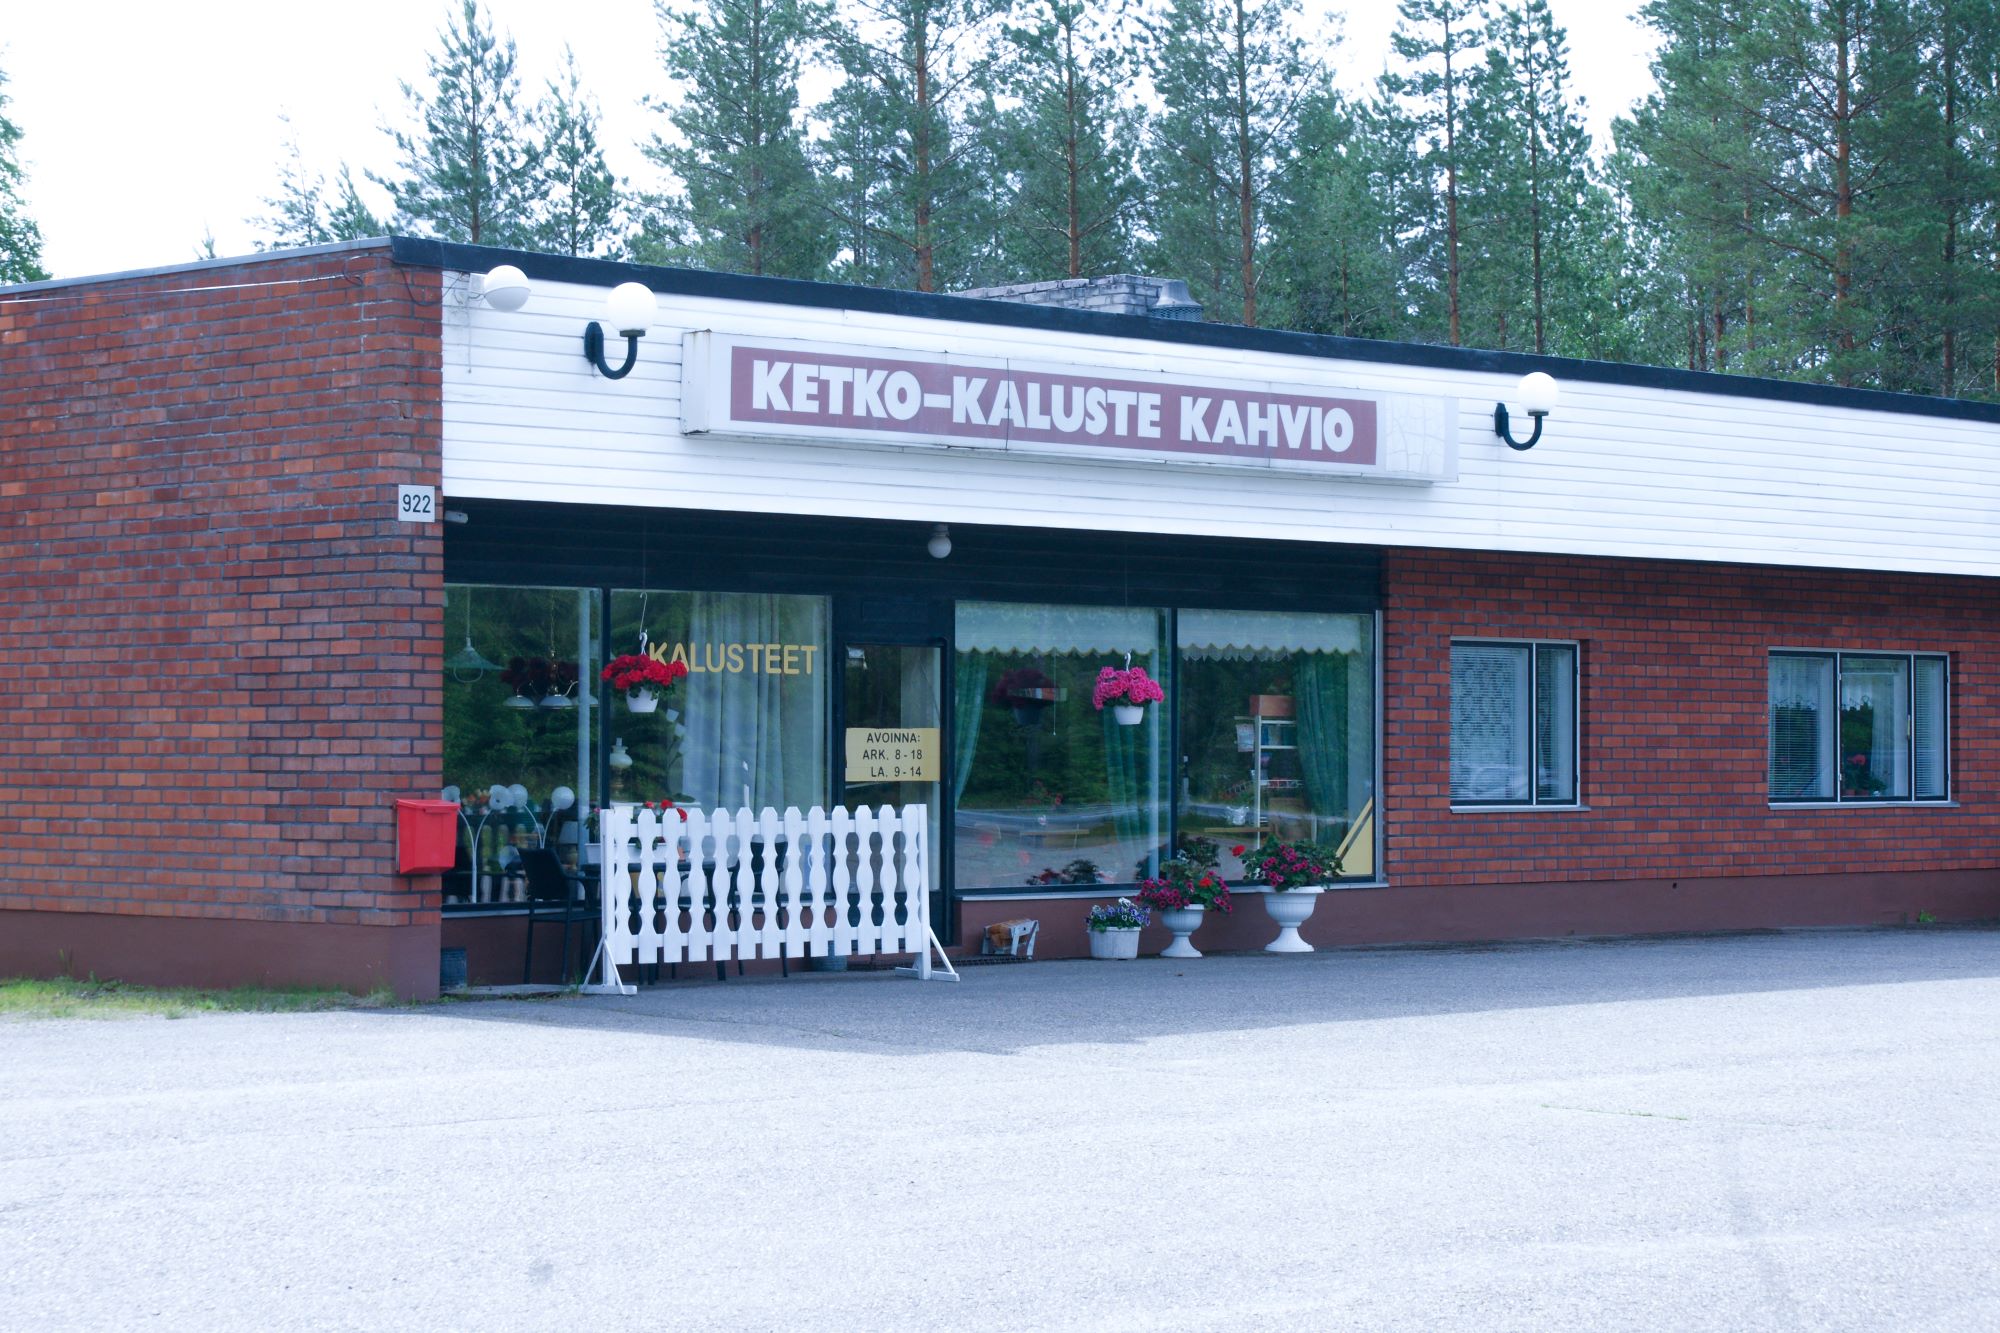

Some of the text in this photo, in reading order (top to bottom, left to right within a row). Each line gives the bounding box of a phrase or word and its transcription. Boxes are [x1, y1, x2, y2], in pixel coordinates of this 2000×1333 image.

[752, 359, 1354, 453] KETKO-KALUSTE KAHVIO
[402, 494, 431, 513] 922
[650, 642, 817, 675] KALUSTEET
[866, 732, 921, 743] AVOINNA:
